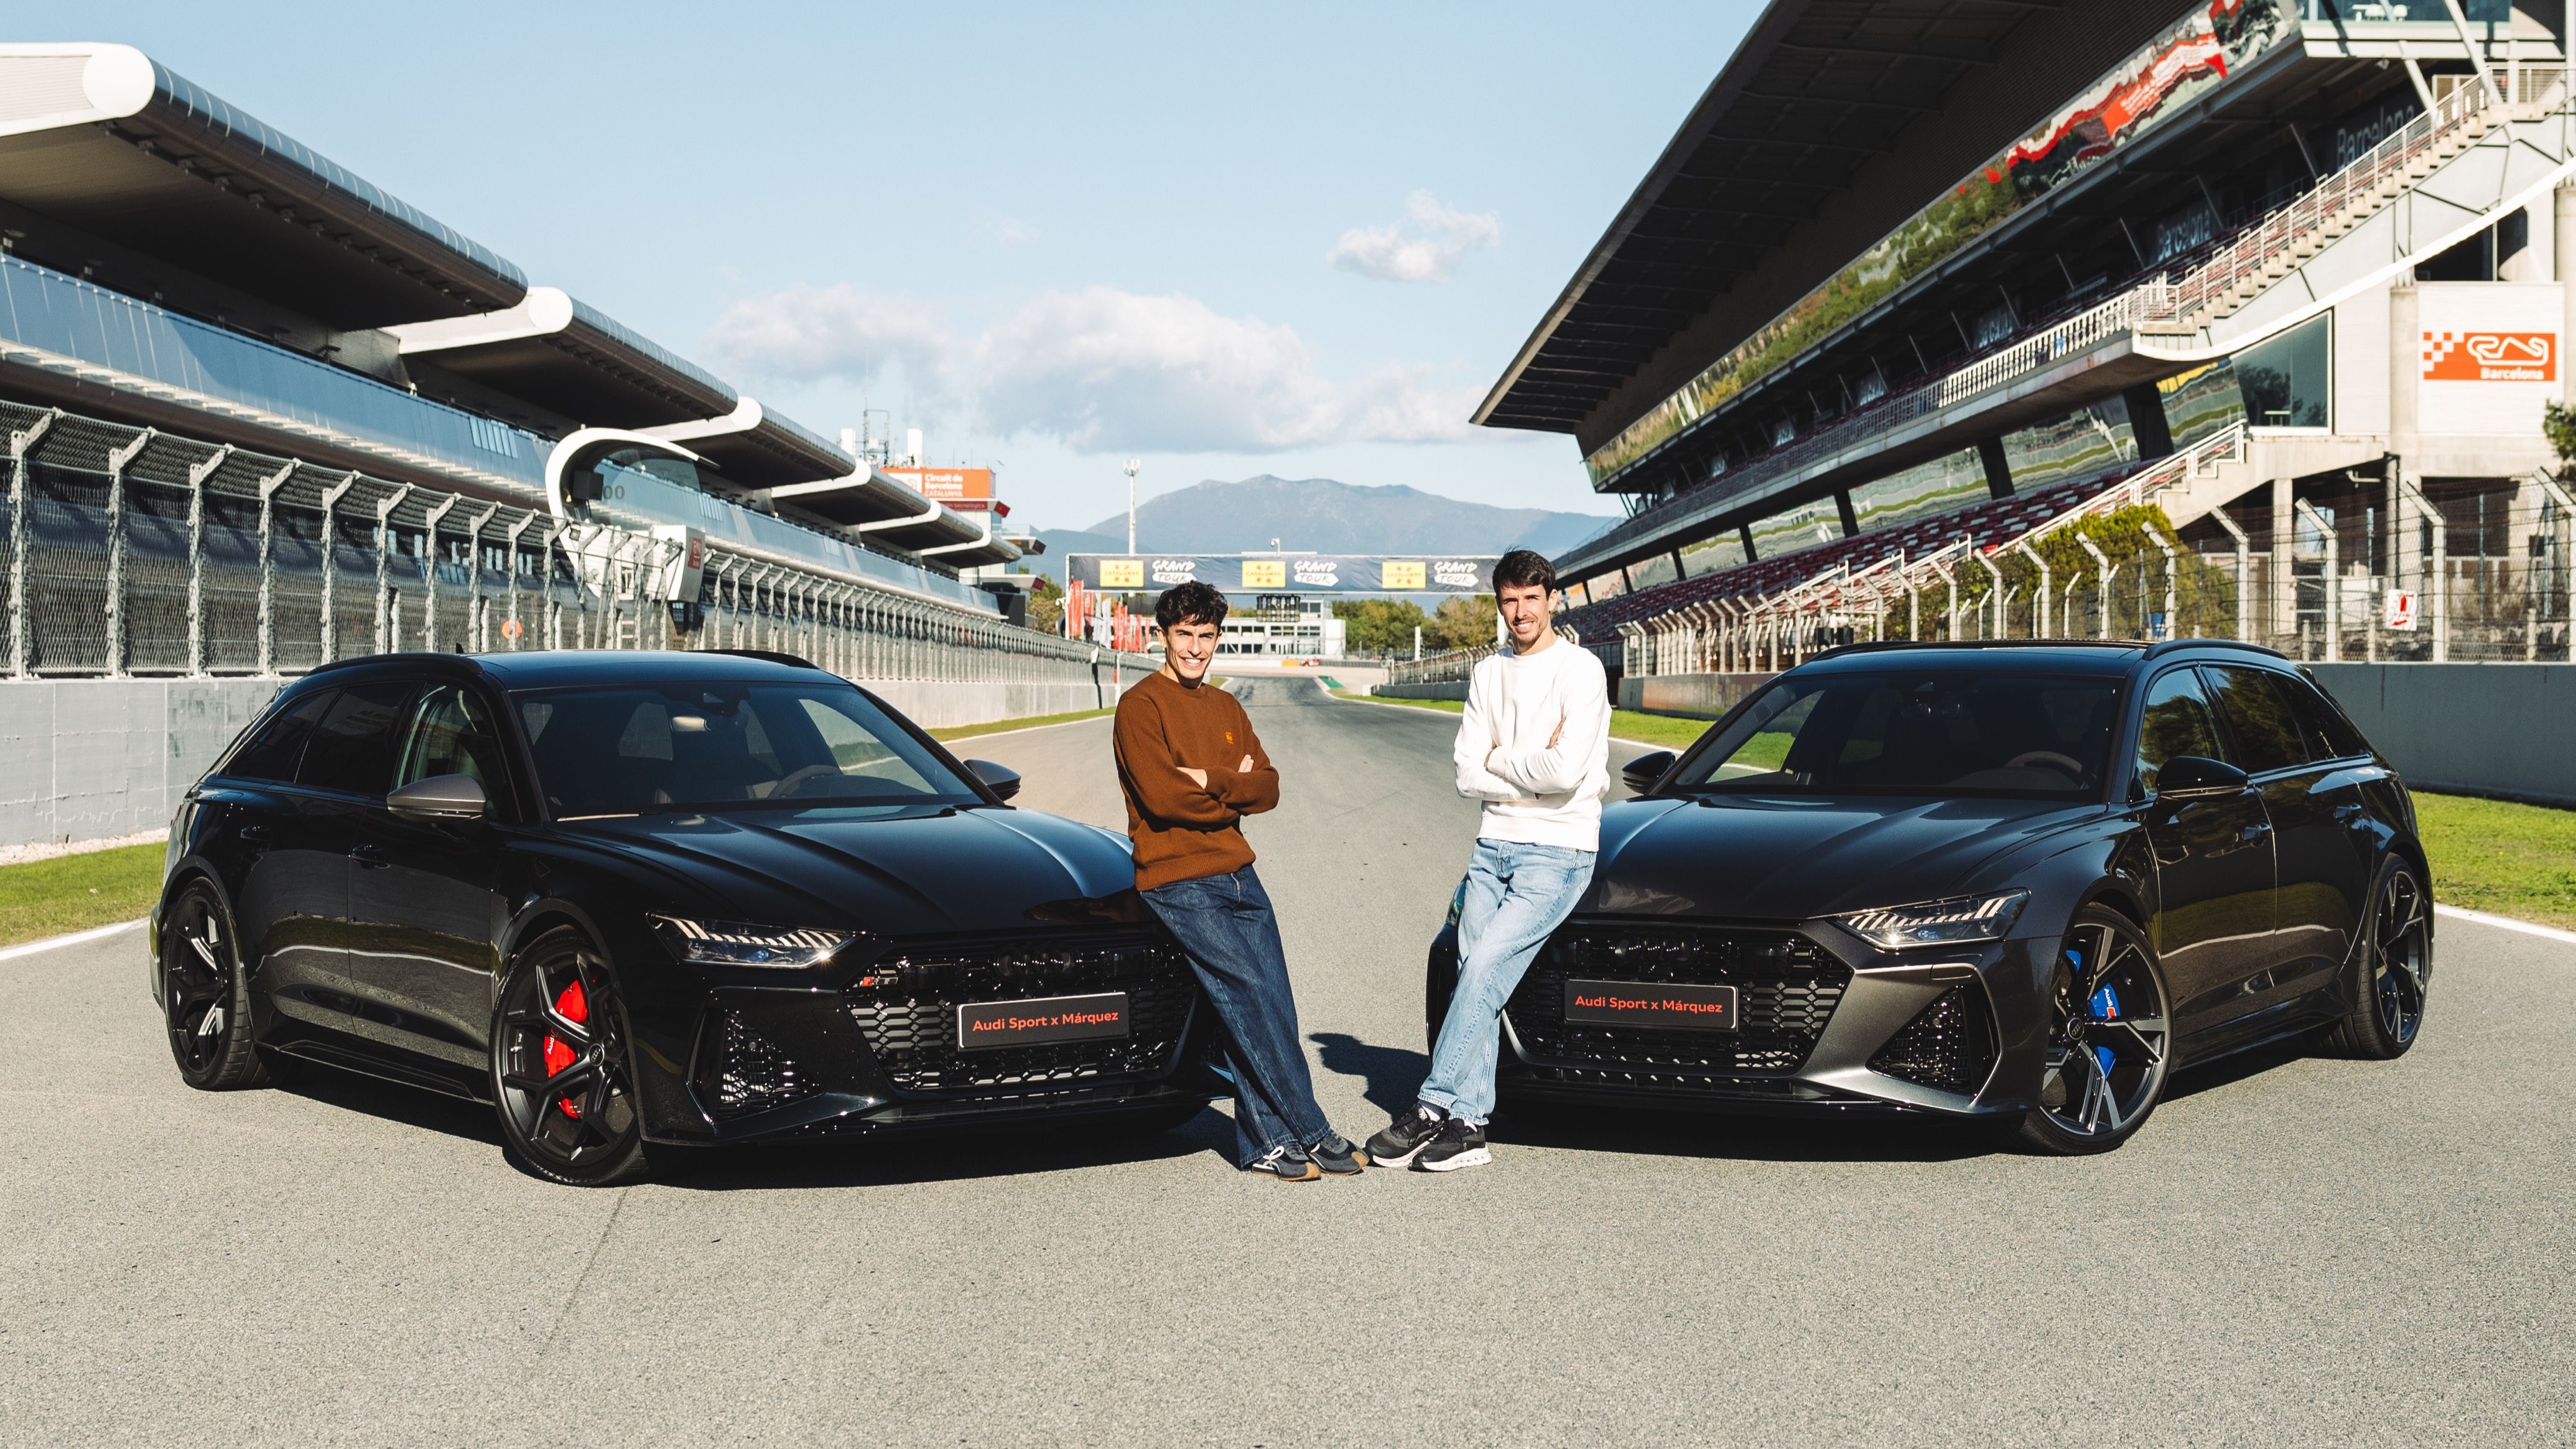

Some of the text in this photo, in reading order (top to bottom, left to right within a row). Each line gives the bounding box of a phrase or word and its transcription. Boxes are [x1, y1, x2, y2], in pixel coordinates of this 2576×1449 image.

[2481, 366, 2544, 380] Barcelona
[925, 473, 963, 483] Circuit de
[925, 482, 963, 490] Barcelona
[1152, 559, 1196, 572] GRAND
[1294, 561, 1337, 573] GRAND
[1434, 561, 1478, 574] GRAND
[1159, 574, 1188, 582] TOUR
[1300, 574, 1330, 584] TOUR
[1440, 575, 1471, 584] TOUR
[1575, 995, 1606, 1007] Audi
[1610, 997, 1647, 1010] Sport
[1663, 1000, 1723, 1013] Márquez
[2104, 989, 2113, 1007] Audi
[973, 1012, 1118, 1032] Audi Sport x Márquez
